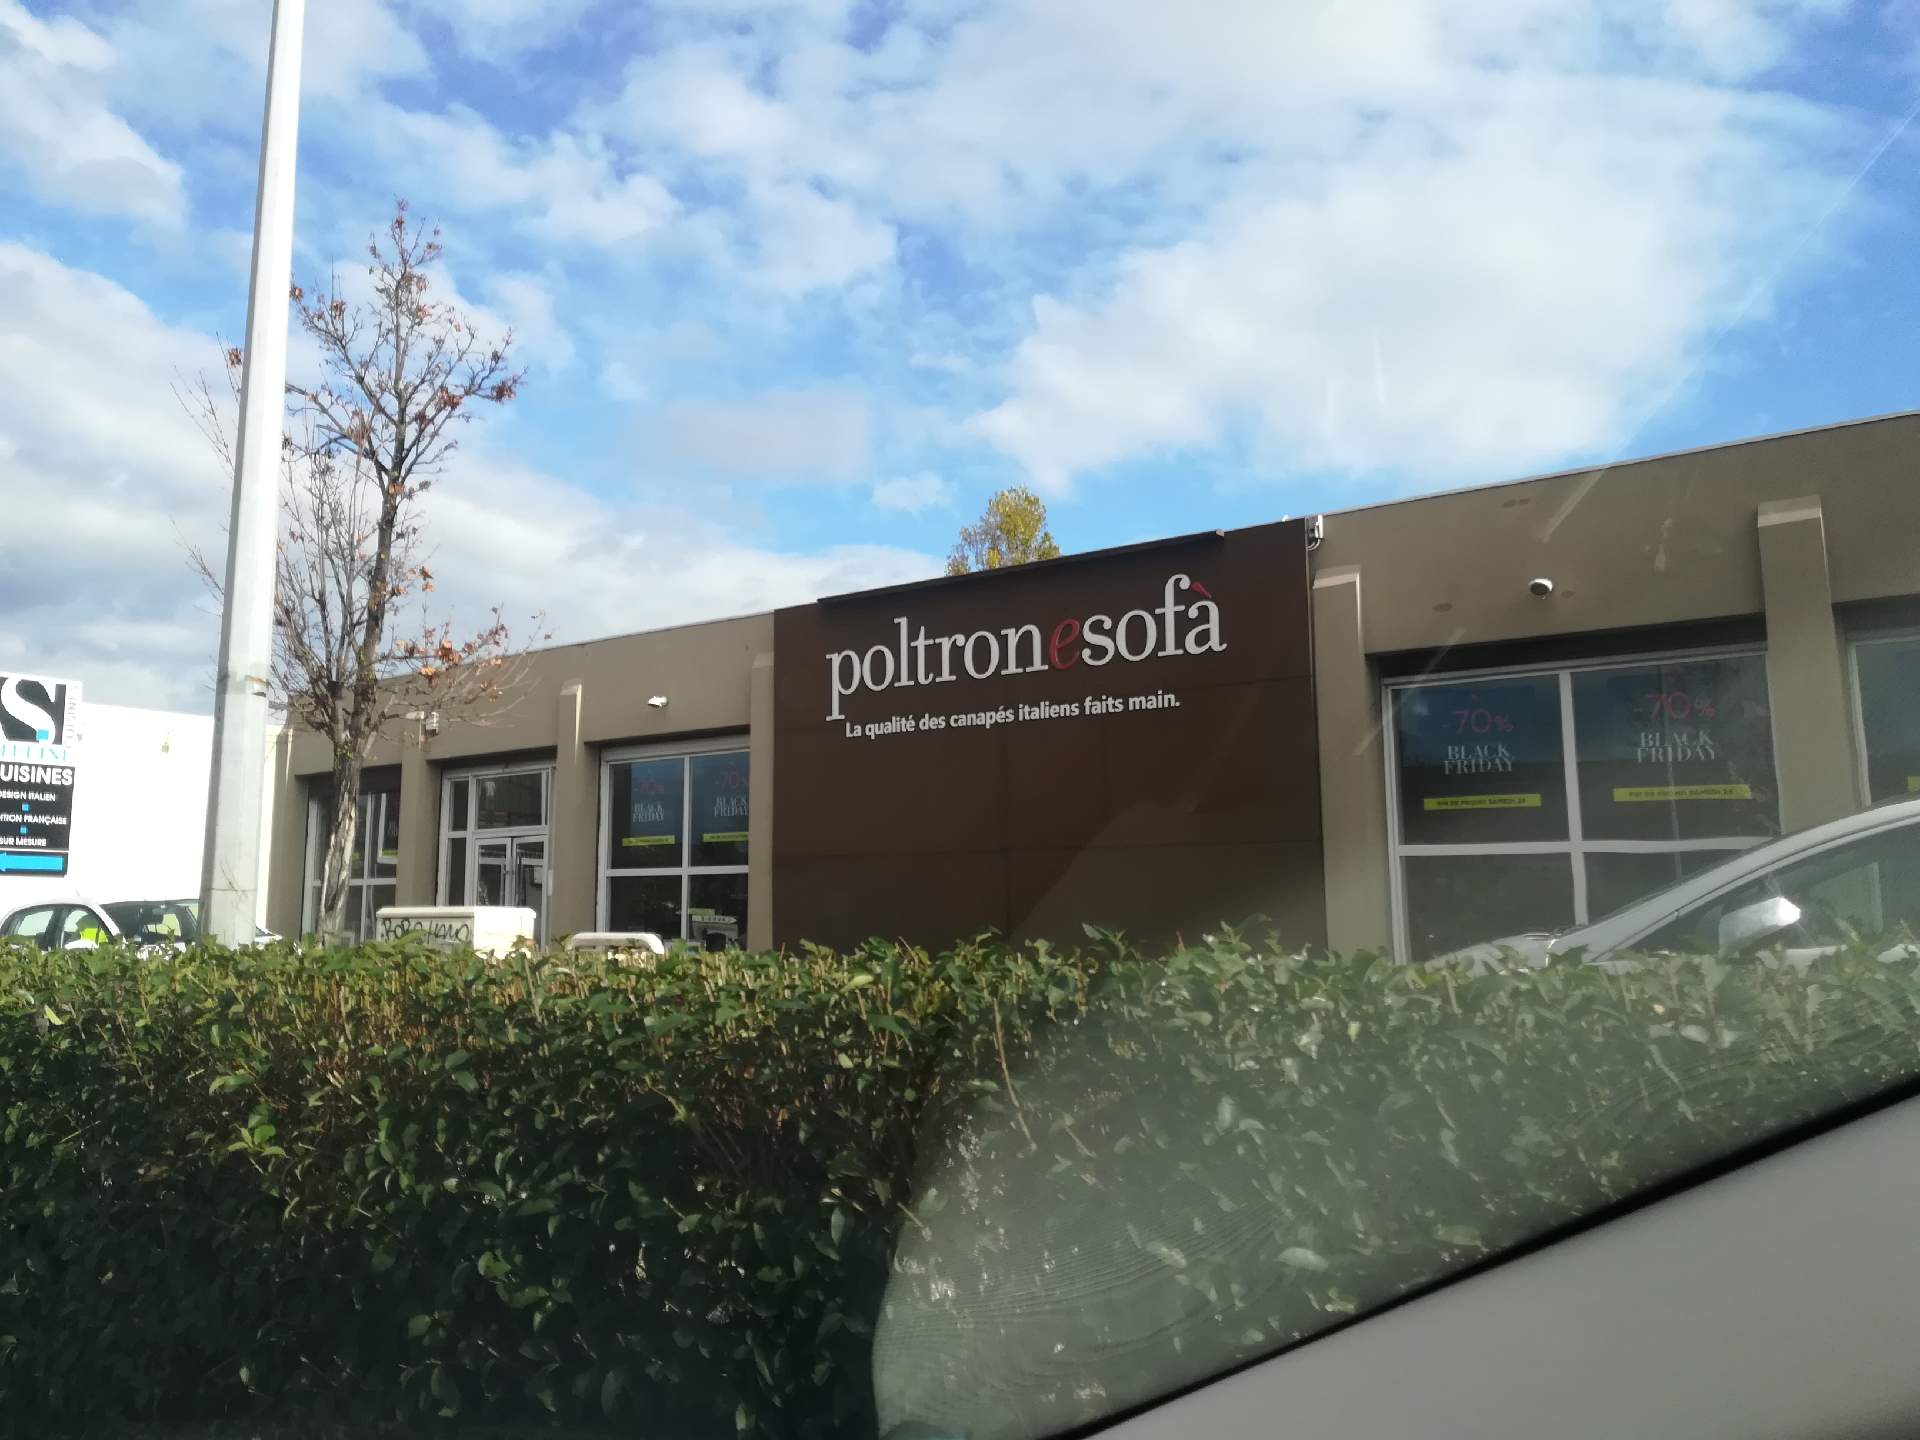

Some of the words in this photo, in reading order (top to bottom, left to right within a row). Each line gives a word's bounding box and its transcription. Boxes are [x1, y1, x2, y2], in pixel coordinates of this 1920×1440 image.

[825, 573, 1228, 721] poltronesofà
[845, 721, 862, 738] La
[865, 714, 916, 740] qualité
[918, 713, 946, 731] des
[949, 705, 1014, 729] canapés
[1018, 701, 1080, 721] italiens
[1083, 695, 1124, 715] faits
[1128, 689, 1180, 711] main.
[1447, 743, 1510, 760] BLACK
[1444, 757, 1513, 775] FRIDAY
[28, 791, 56, 802] ITALIEN
